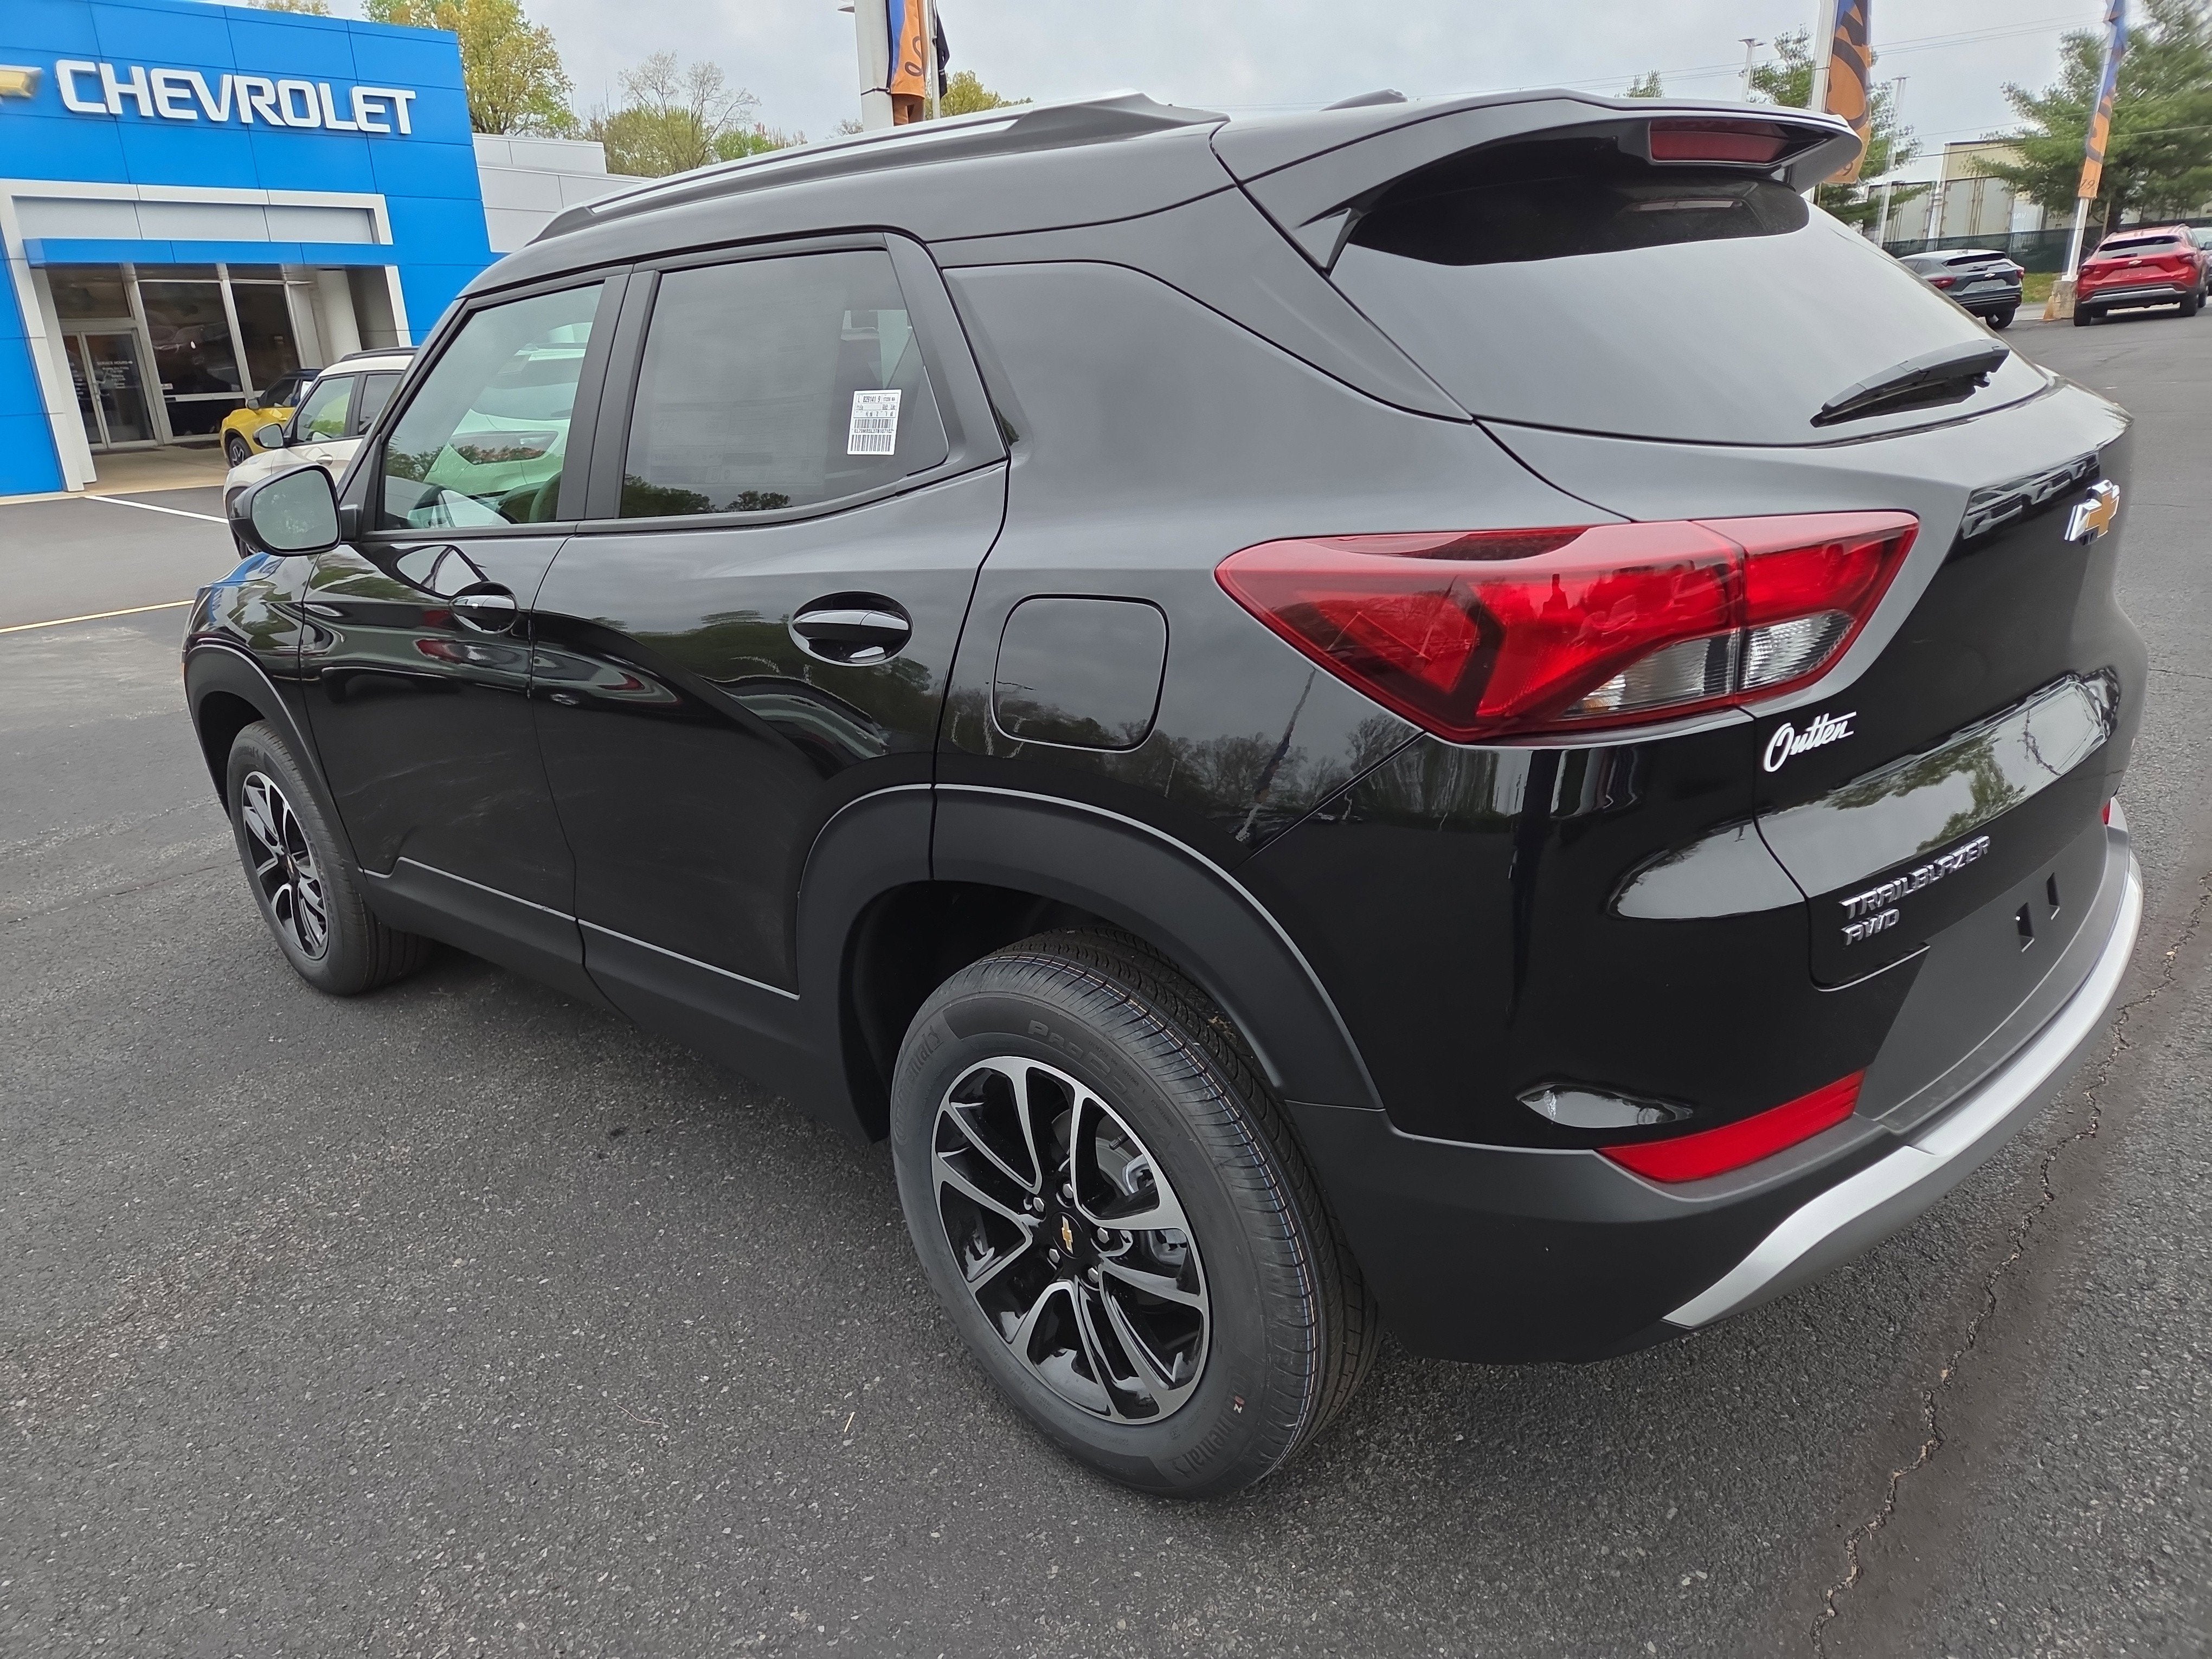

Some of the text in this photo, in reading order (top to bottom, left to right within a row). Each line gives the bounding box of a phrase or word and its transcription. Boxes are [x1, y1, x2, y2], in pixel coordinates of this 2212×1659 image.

[56, 59, 416, 134] CHEVROLET
[1764, 711, 1857, 772] Outten
[1838, 835, 1991, 919] TRAILBLAZER
[1841, 909, 1900, 946] AWD
